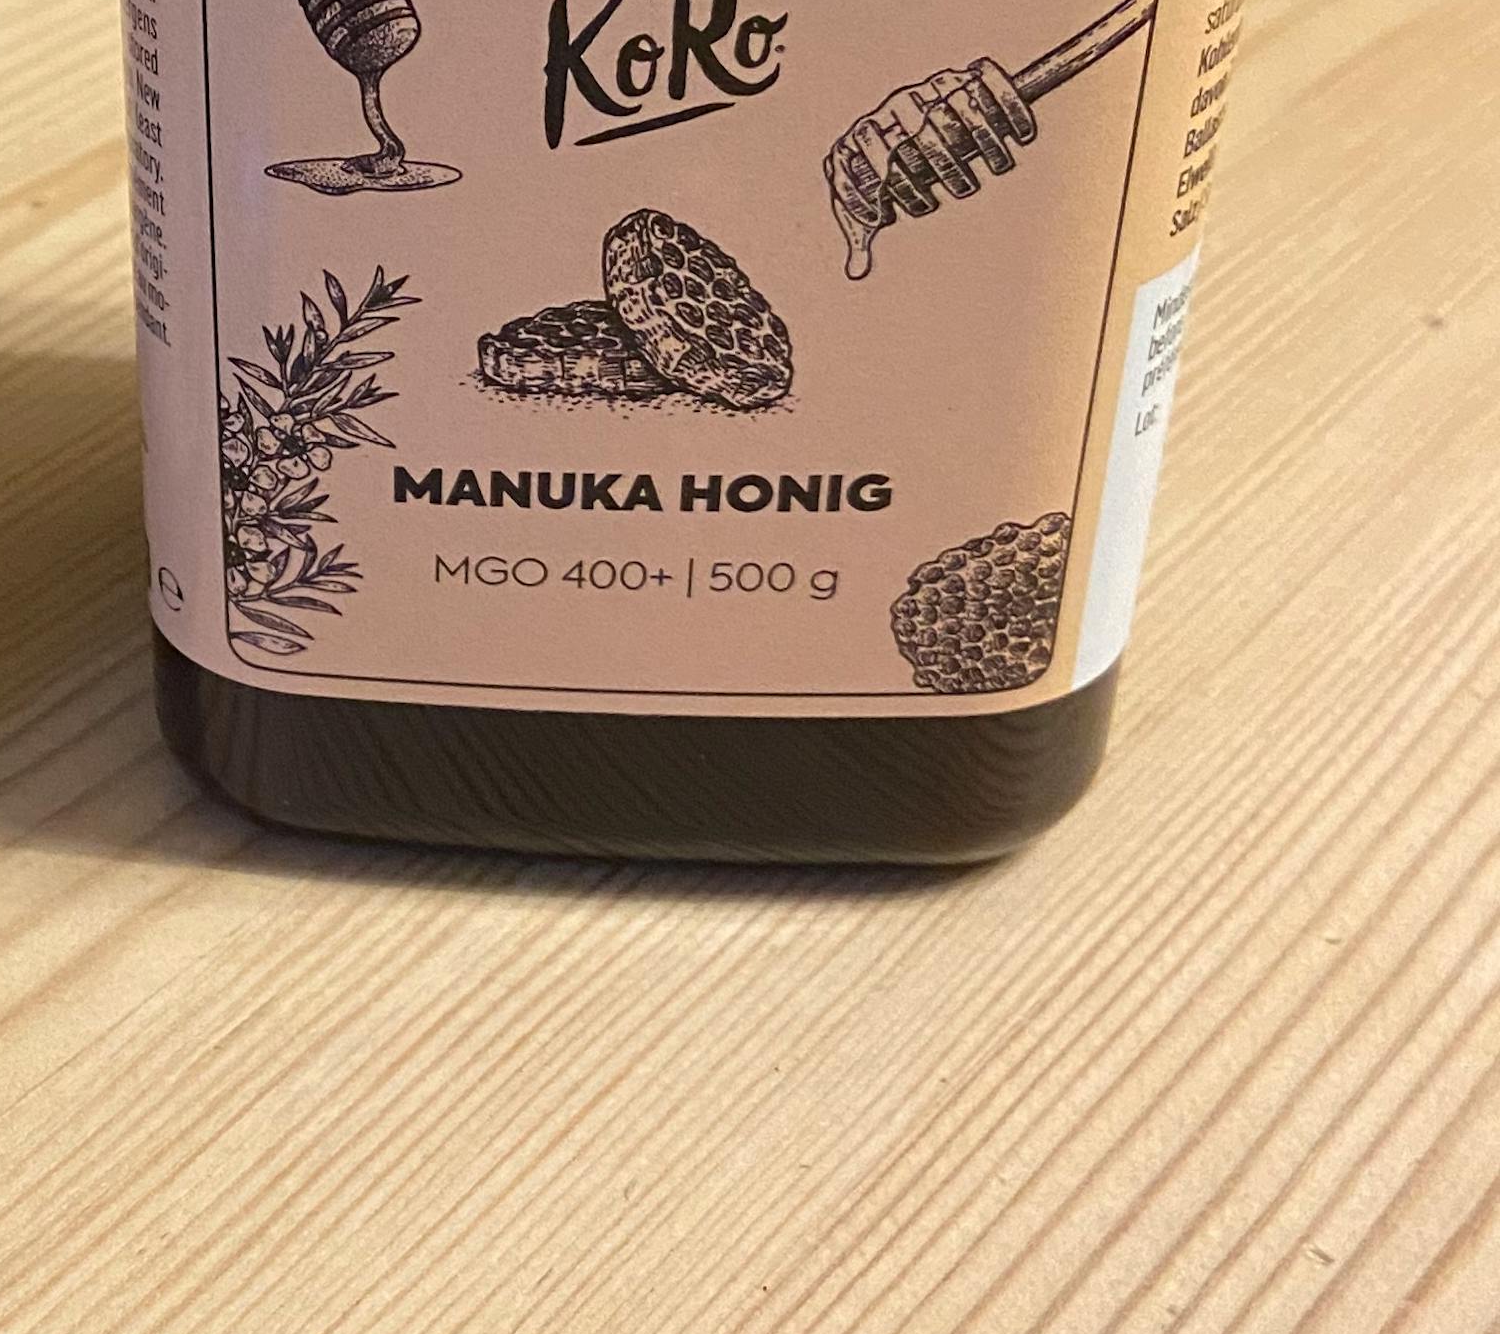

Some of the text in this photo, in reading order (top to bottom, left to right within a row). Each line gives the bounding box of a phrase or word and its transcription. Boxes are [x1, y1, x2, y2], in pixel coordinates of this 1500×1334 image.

[136, 69, 161, 112] New
[135, 103, 163, 148] least
[393, 466, 893, 513] MANUKA HONIG
[434, 554, 548, 587] MGO
[562, 560, 673, 591] 400+
[708, 562, 796, 593] 500
[809, 569, 840, 601] g
